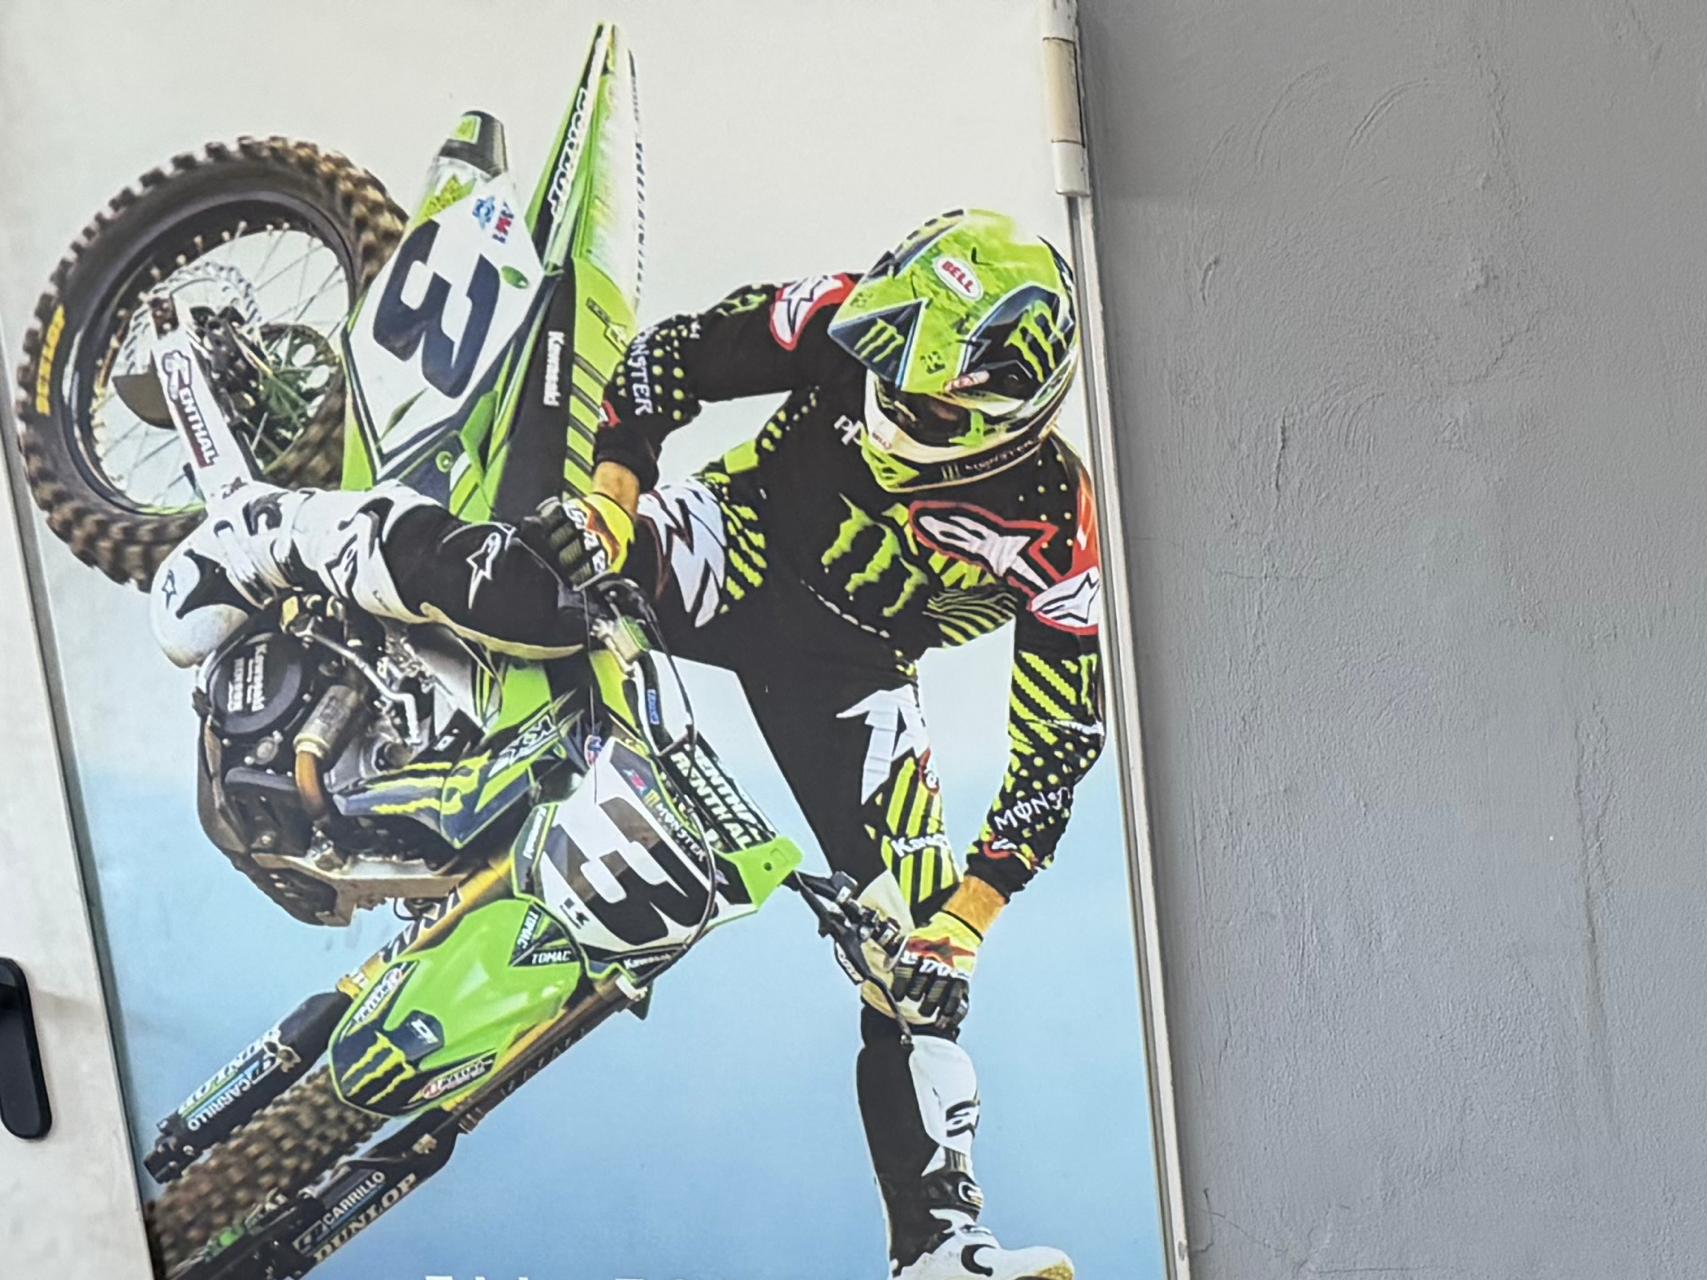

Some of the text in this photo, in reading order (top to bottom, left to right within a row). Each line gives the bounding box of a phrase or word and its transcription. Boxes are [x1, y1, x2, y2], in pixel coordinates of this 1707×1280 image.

[373, 219, 500, 399] 3
[940, 260, 974, 293] BELL
[542, 796, 719, 945] 3
[312, 1172, 418, 1262] DUNLOP
[322, 1170, 386, 1227] CARRILLO
